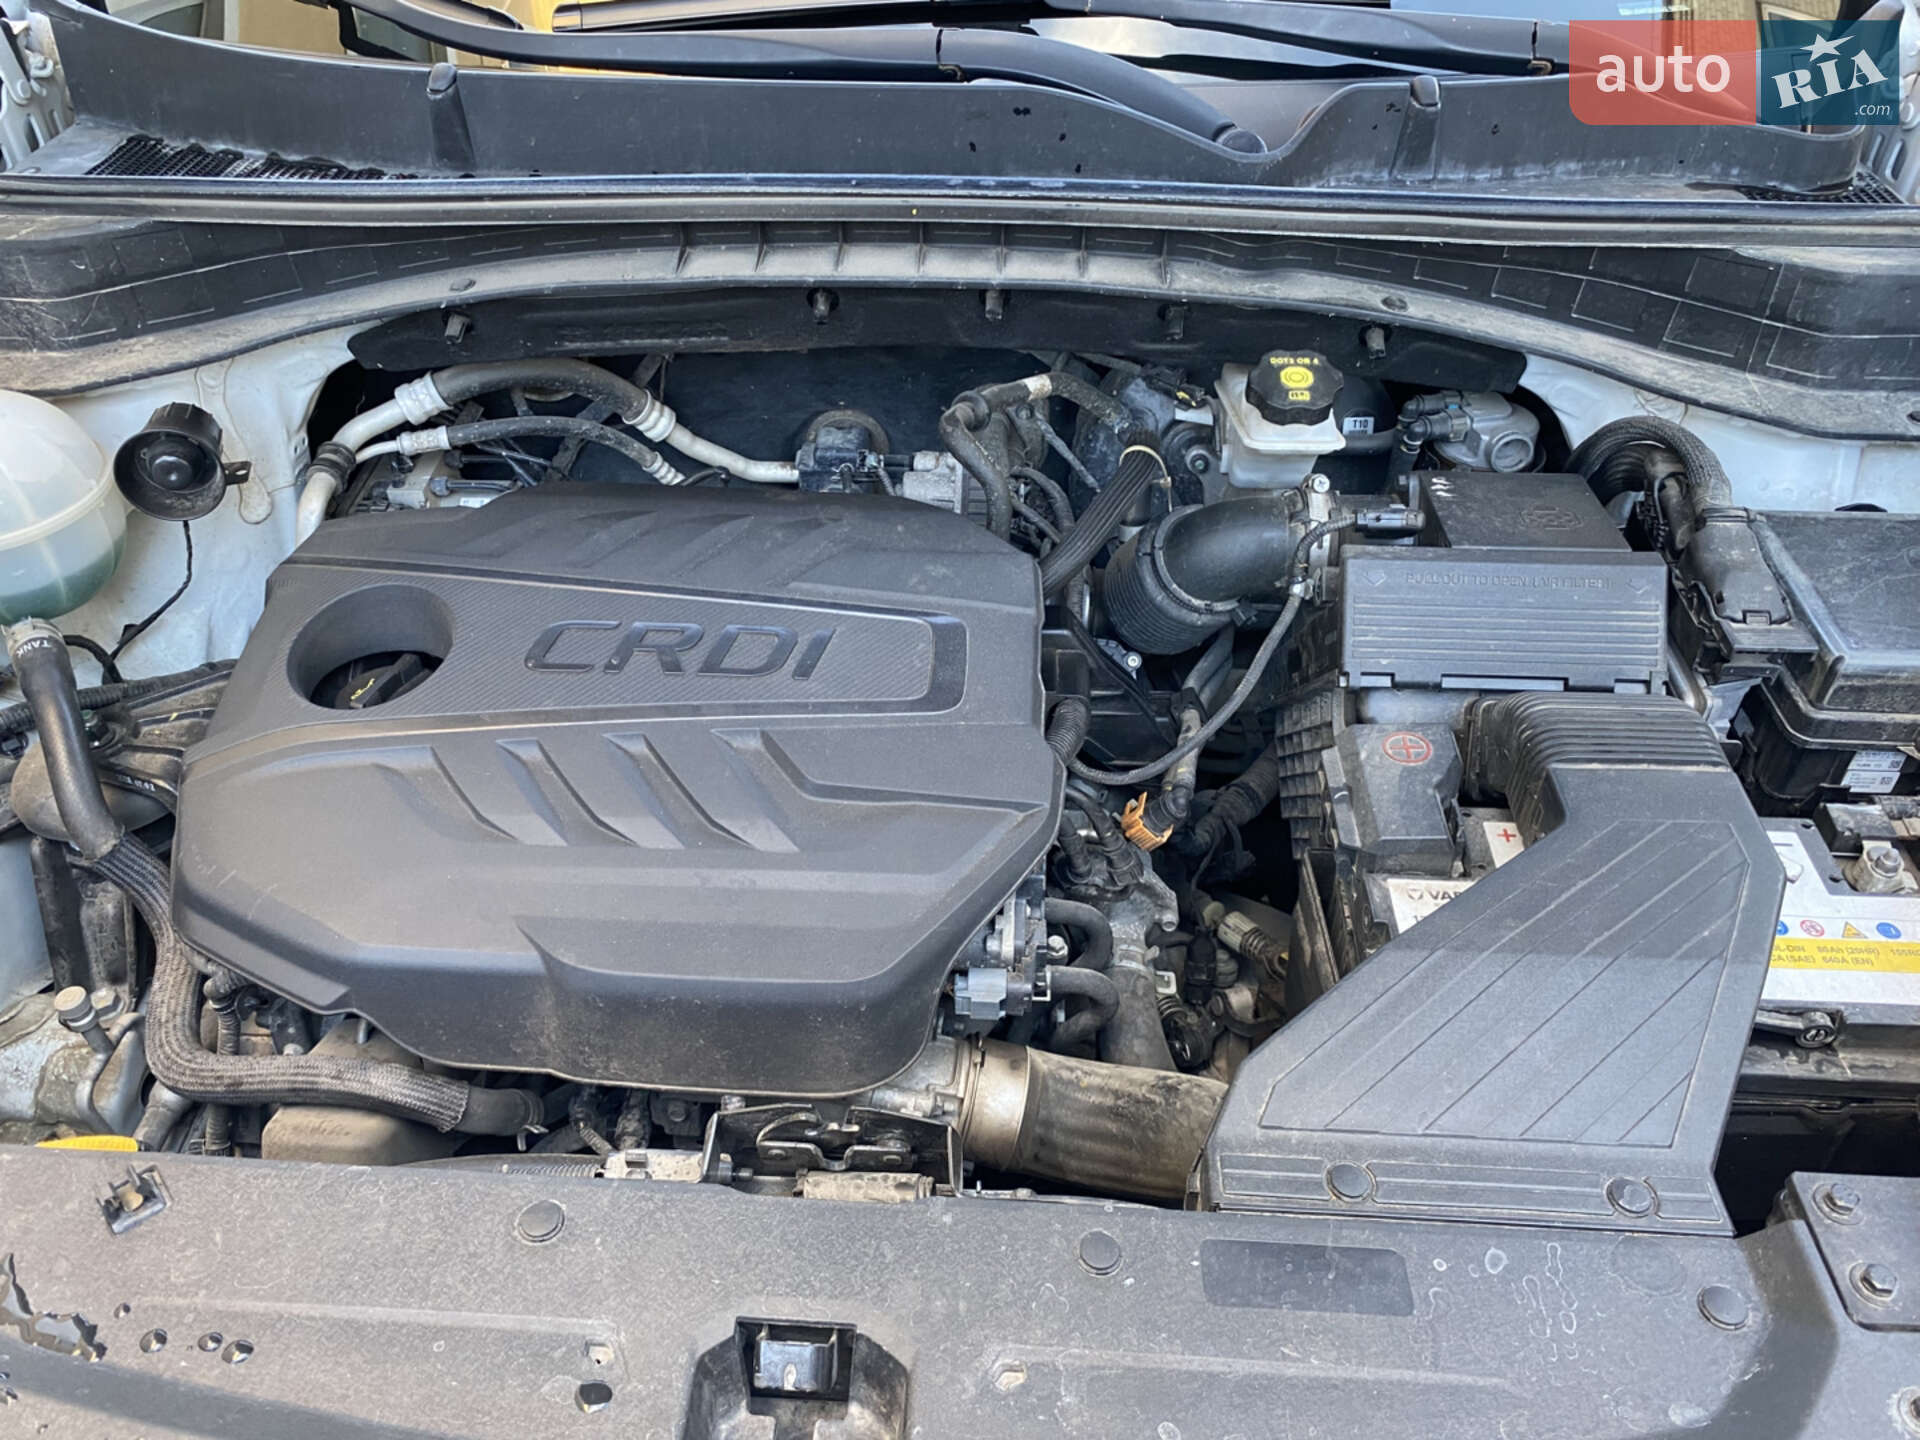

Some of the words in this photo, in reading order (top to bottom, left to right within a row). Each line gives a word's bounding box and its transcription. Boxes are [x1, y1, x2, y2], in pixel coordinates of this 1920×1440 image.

[1352, 419, 1369, 429] T10
[16, 639, 52, 659] TANK
[523, 619, 837, 681] CRDI
